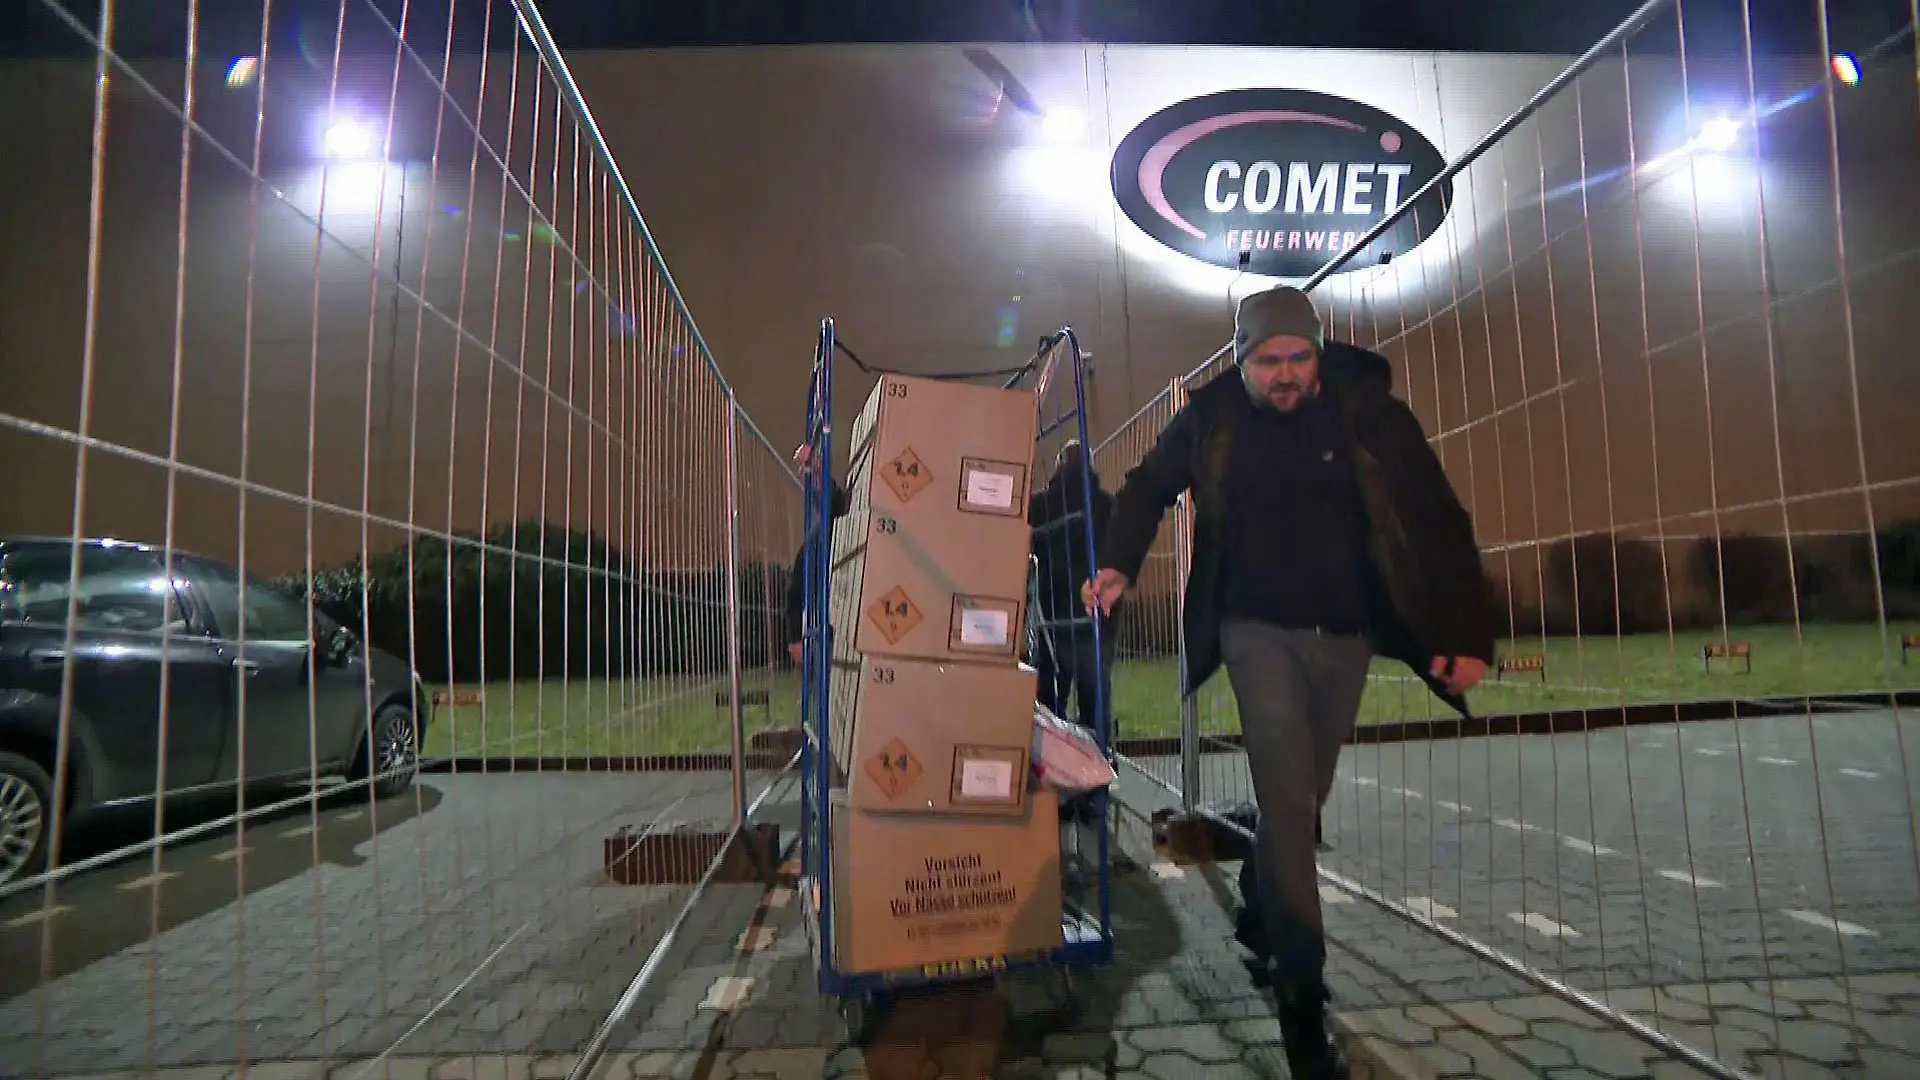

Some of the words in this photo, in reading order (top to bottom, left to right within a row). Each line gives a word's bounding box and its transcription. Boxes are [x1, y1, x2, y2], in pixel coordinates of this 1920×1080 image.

[1203, 159, 1413, 215] COMET
[888, 383, 908, 398] 33
[875, 517, 897, 534] 33
[872, 667, 895, 685] 33
[905, 875, 941, 893] Nicht
[890, 897, 911, 917] Vor
